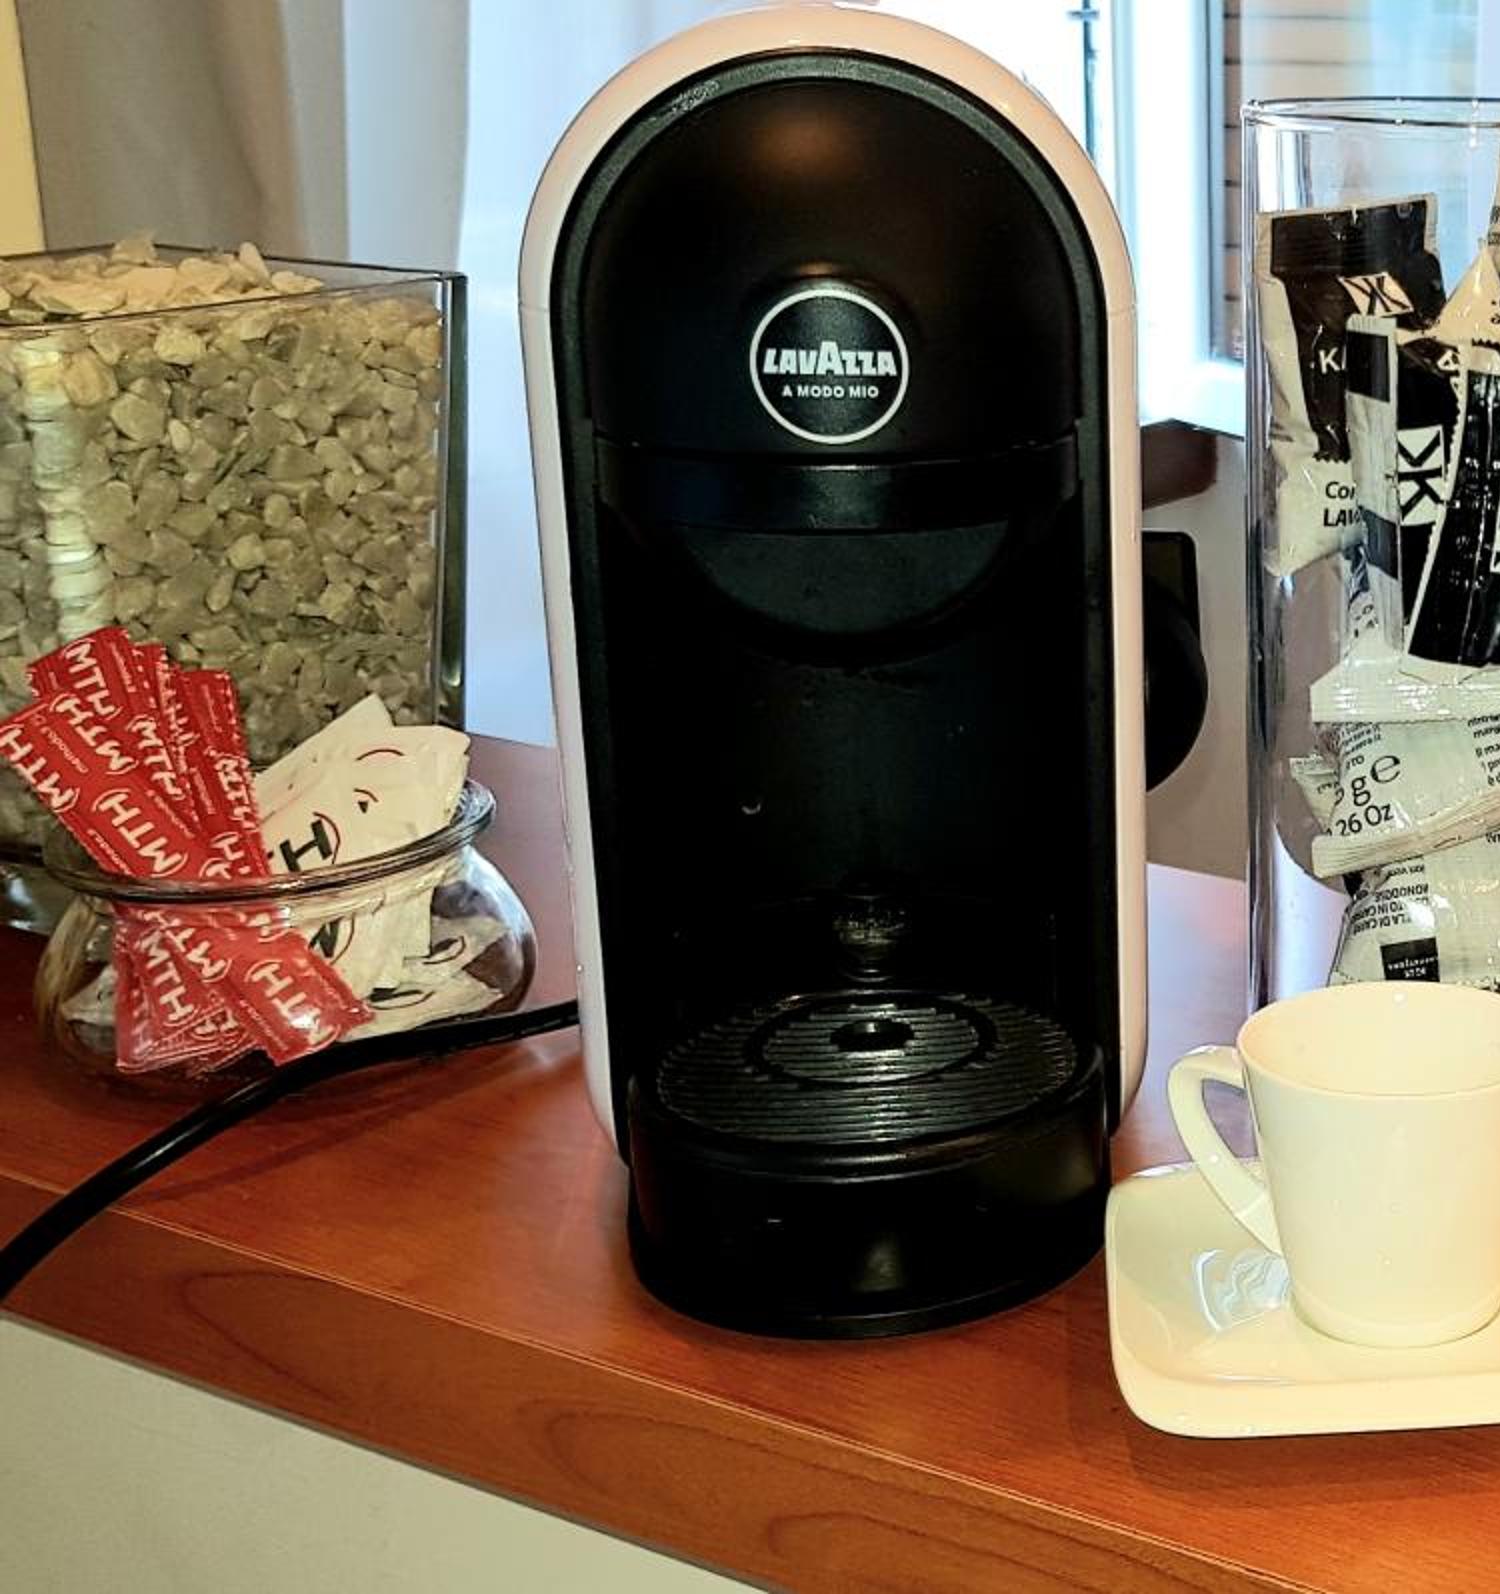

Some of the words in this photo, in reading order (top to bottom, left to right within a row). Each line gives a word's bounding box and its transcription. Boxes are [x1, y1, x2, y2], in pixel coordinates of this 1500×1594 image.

[763, 341, 897, 376] LAVAZZA
[782, 386, 792, 397] A
[797, 386, 845, 398] MODO
[849, 386, 879, 398] MIO
[1364, 803, 1395, 827] Oz
